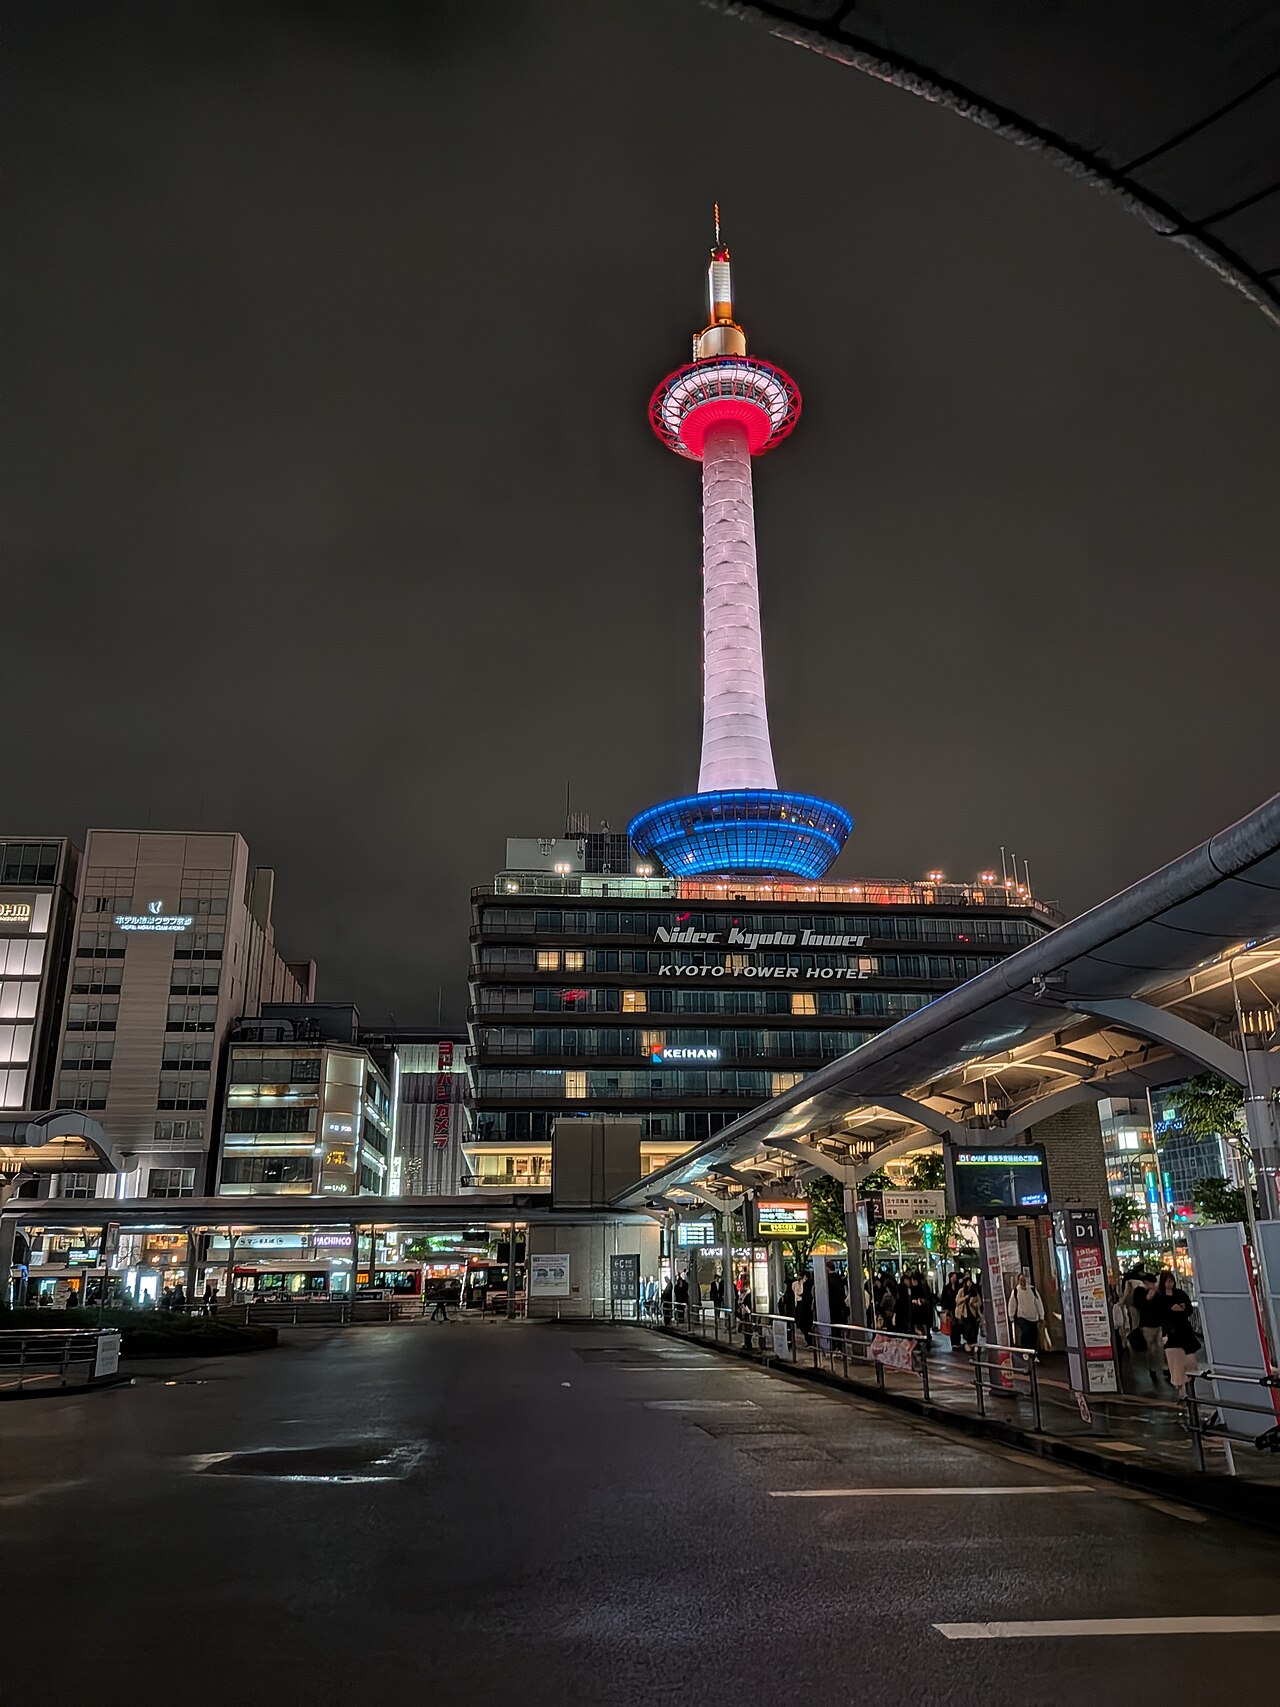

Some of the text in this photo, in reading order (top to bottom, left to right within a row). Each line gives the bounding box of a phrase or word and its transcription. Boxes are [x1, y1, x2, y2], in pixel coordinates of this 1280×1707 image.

[653, 926, 871, 950] Nidec Kyoto Tower
[658, 965, 869, 980] KYOTO TOWER HOTEL
[663, 1048, 718, 1059] KEIHAN
[433, 1041, 454, 1149] ヨドバシカメラ
[1075, 1225, 1094, 1238] D1
[755, 1252, 766, 1260] D2
